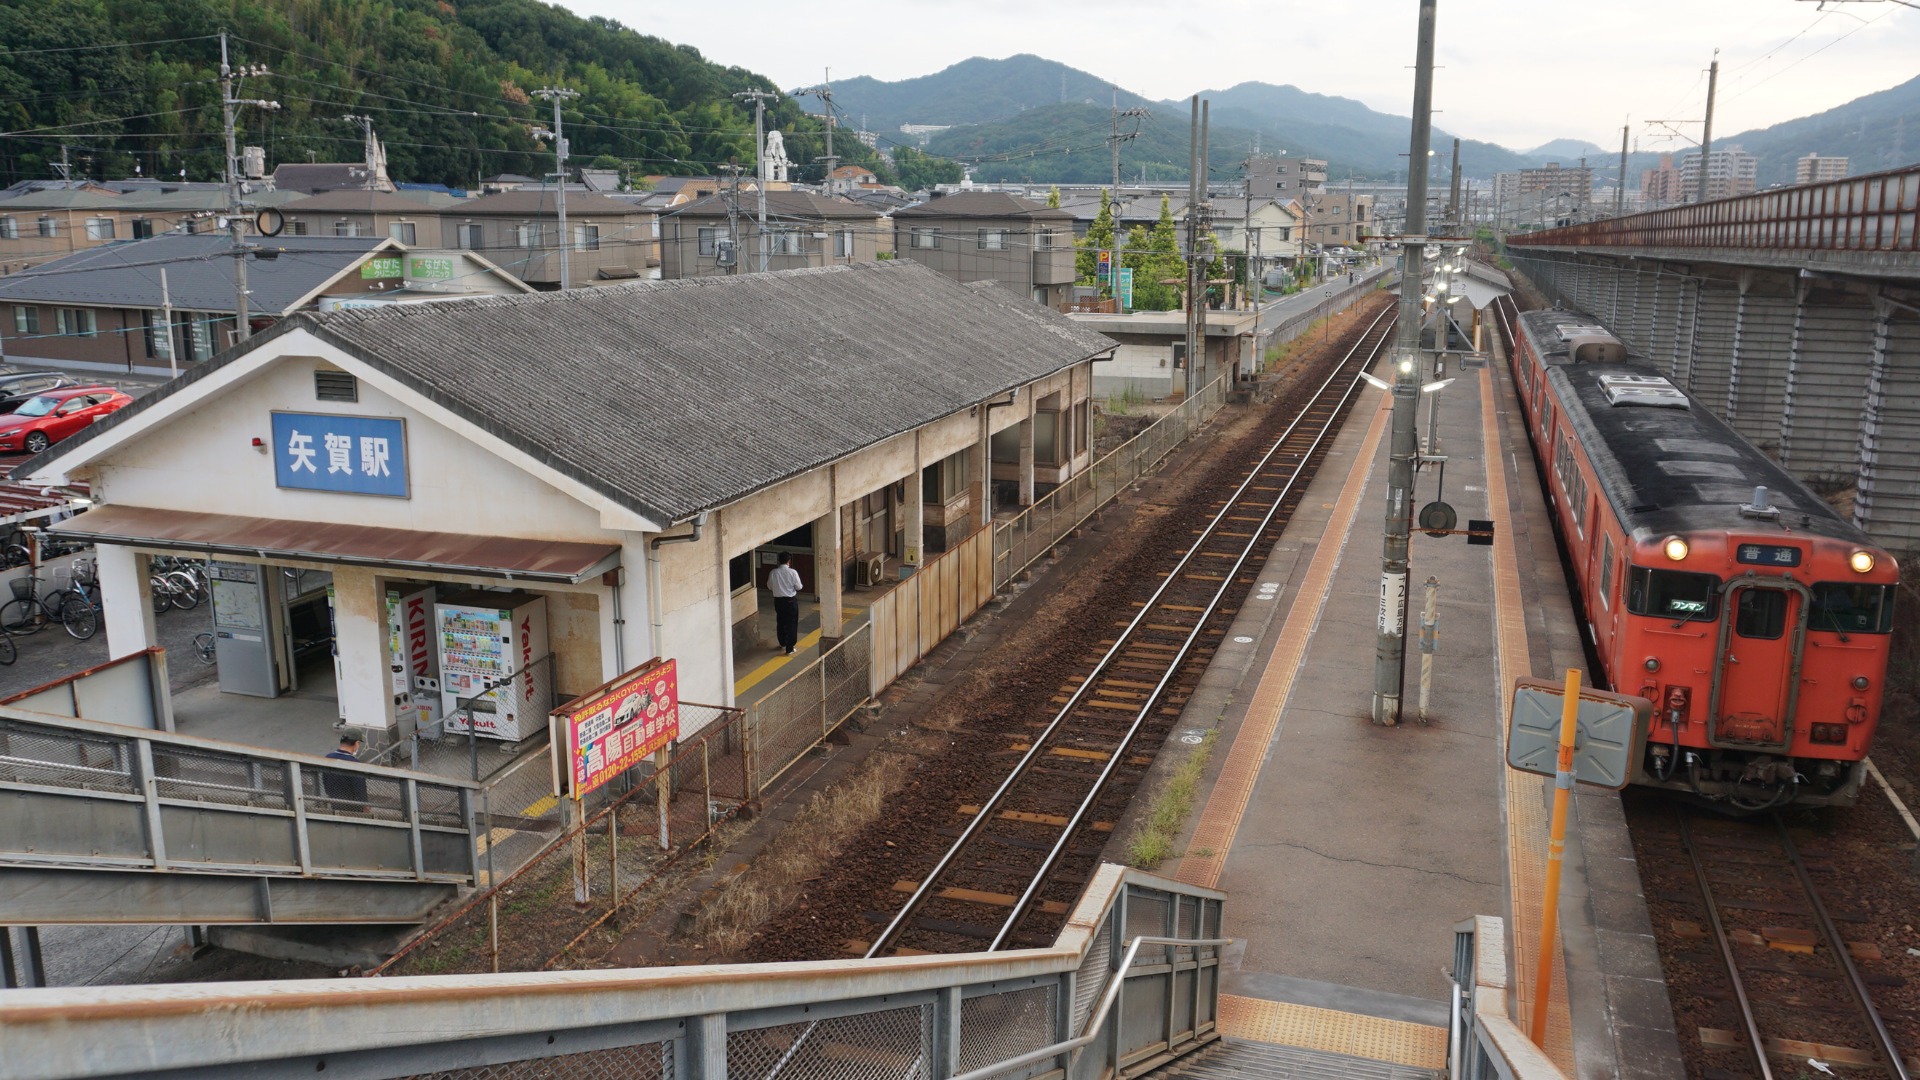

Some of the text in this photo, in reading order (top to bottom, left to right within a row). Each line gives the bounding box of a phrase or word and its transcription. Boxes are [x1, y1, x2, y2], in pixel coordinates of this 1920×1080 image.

[1100, 251, 1108, 262] P
[373, 259, 400, 269] ながた
[424, 260, 449, 269] ながた
[374, 270, 400, 278] クリニック
[425, 270, 450, 278] クリニック
[288, 429, 391, 478] 矢賀駅
[1743, 545, 1793, 562] 普通
[1398, 585, 1405, 597] 2
[1672, 601, 1705, 611] ワンマン
[407, 597, 428, 676] KIRIN
[521, 614, 534, 702] Yakult
